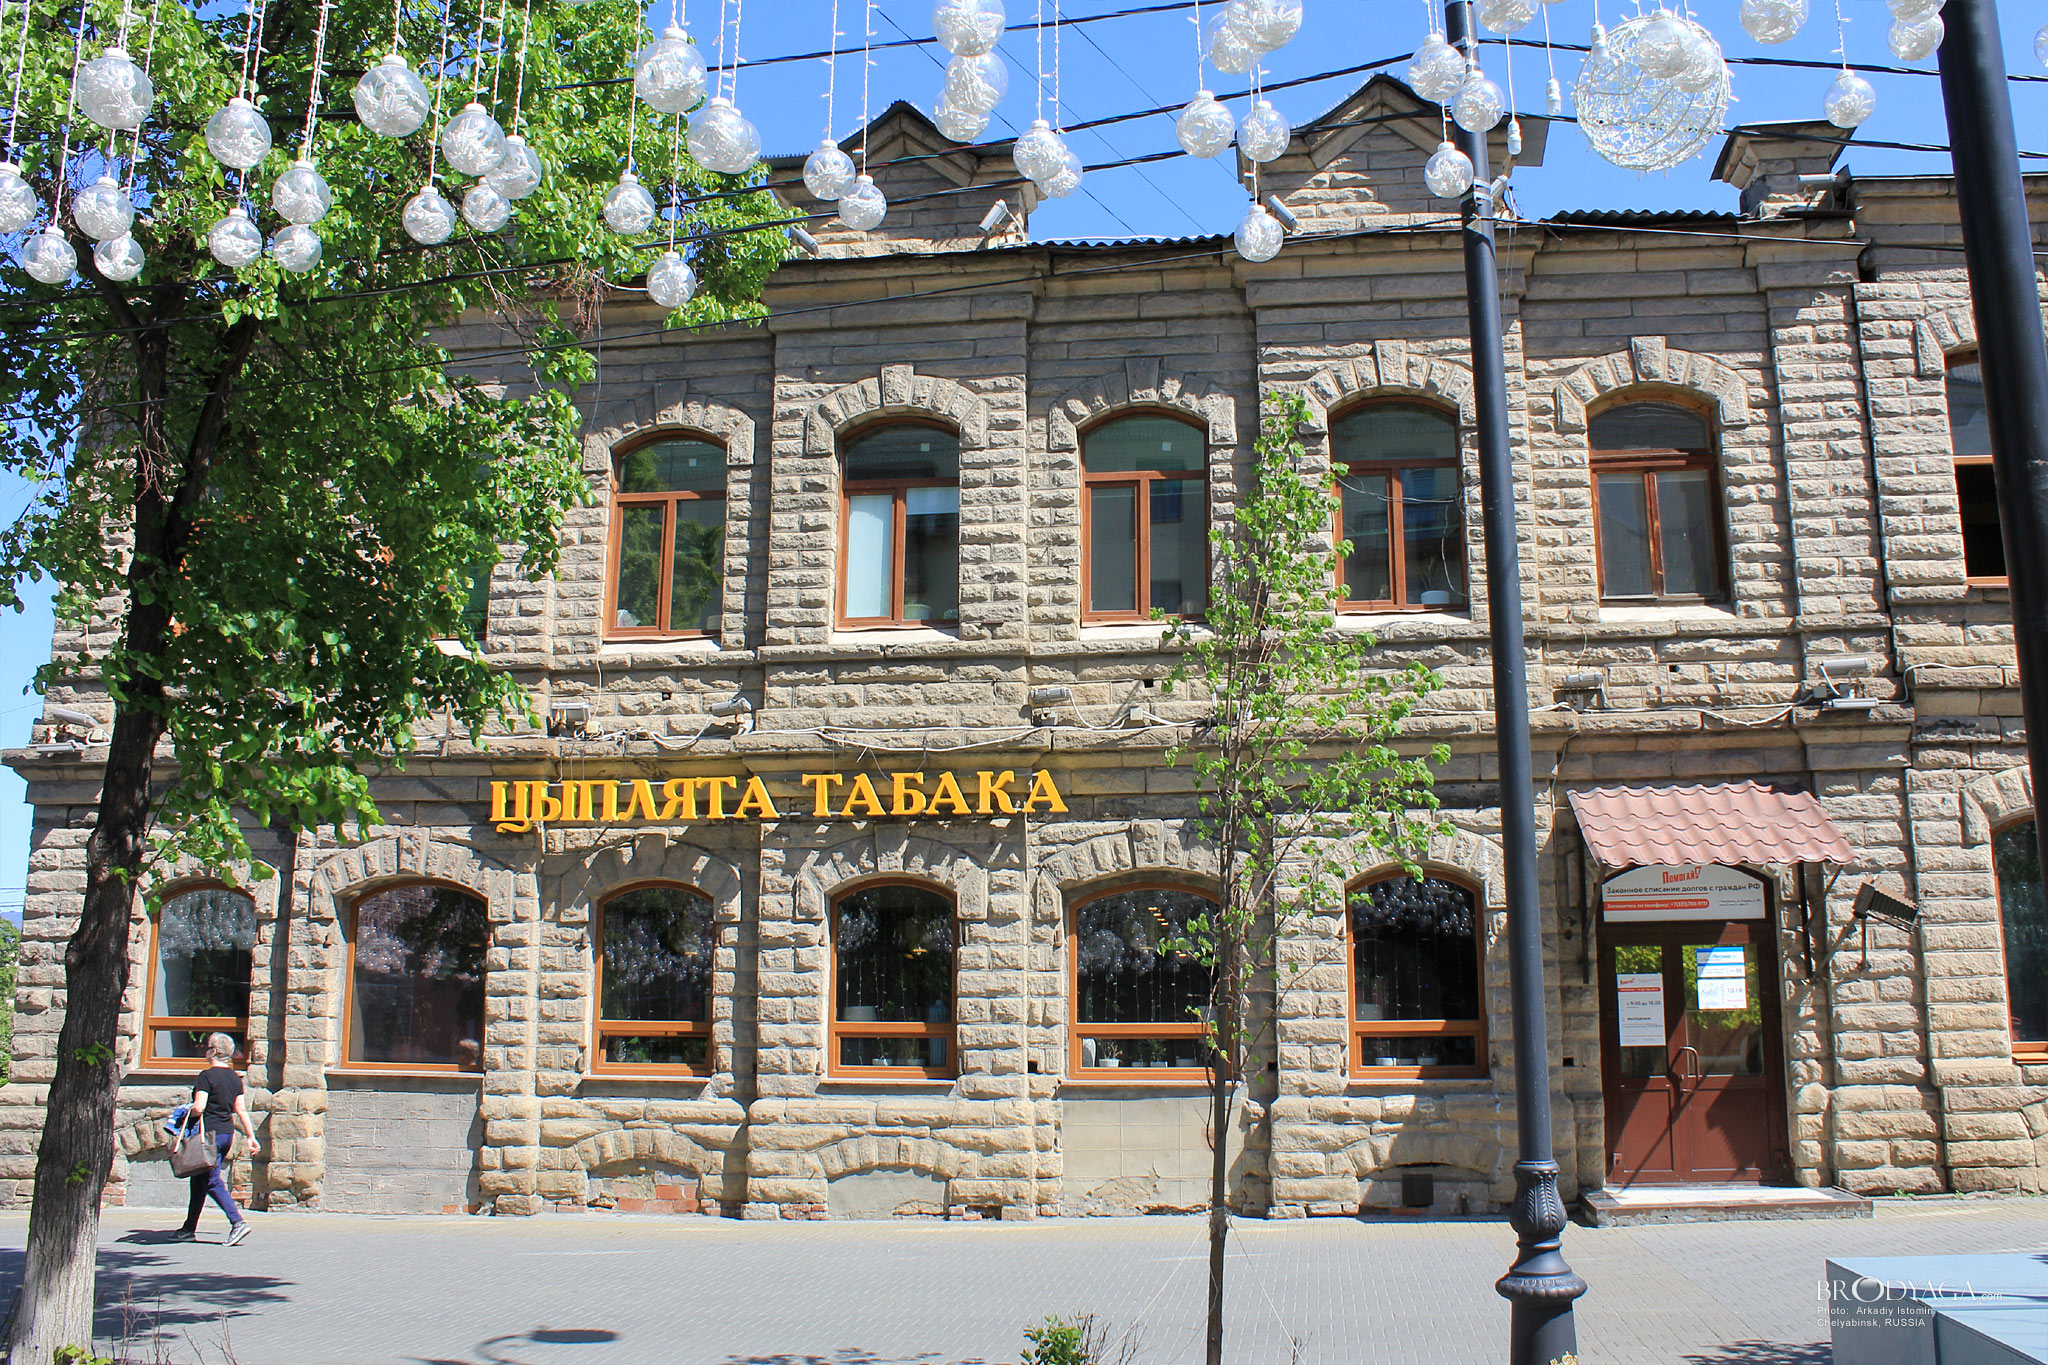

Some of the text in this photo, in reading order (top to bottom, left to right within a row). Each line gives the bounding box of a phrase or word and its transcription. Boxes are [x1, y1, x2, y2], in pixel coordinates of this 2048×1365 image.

[489, 769, 1068, 832] ЦЫПЛЯТА ТАБАКА
[1606, 886, 1643, 894] Законное
[1715, 884, 1746, 893] граждан
[1747, 882, 1761, 890] РФ
